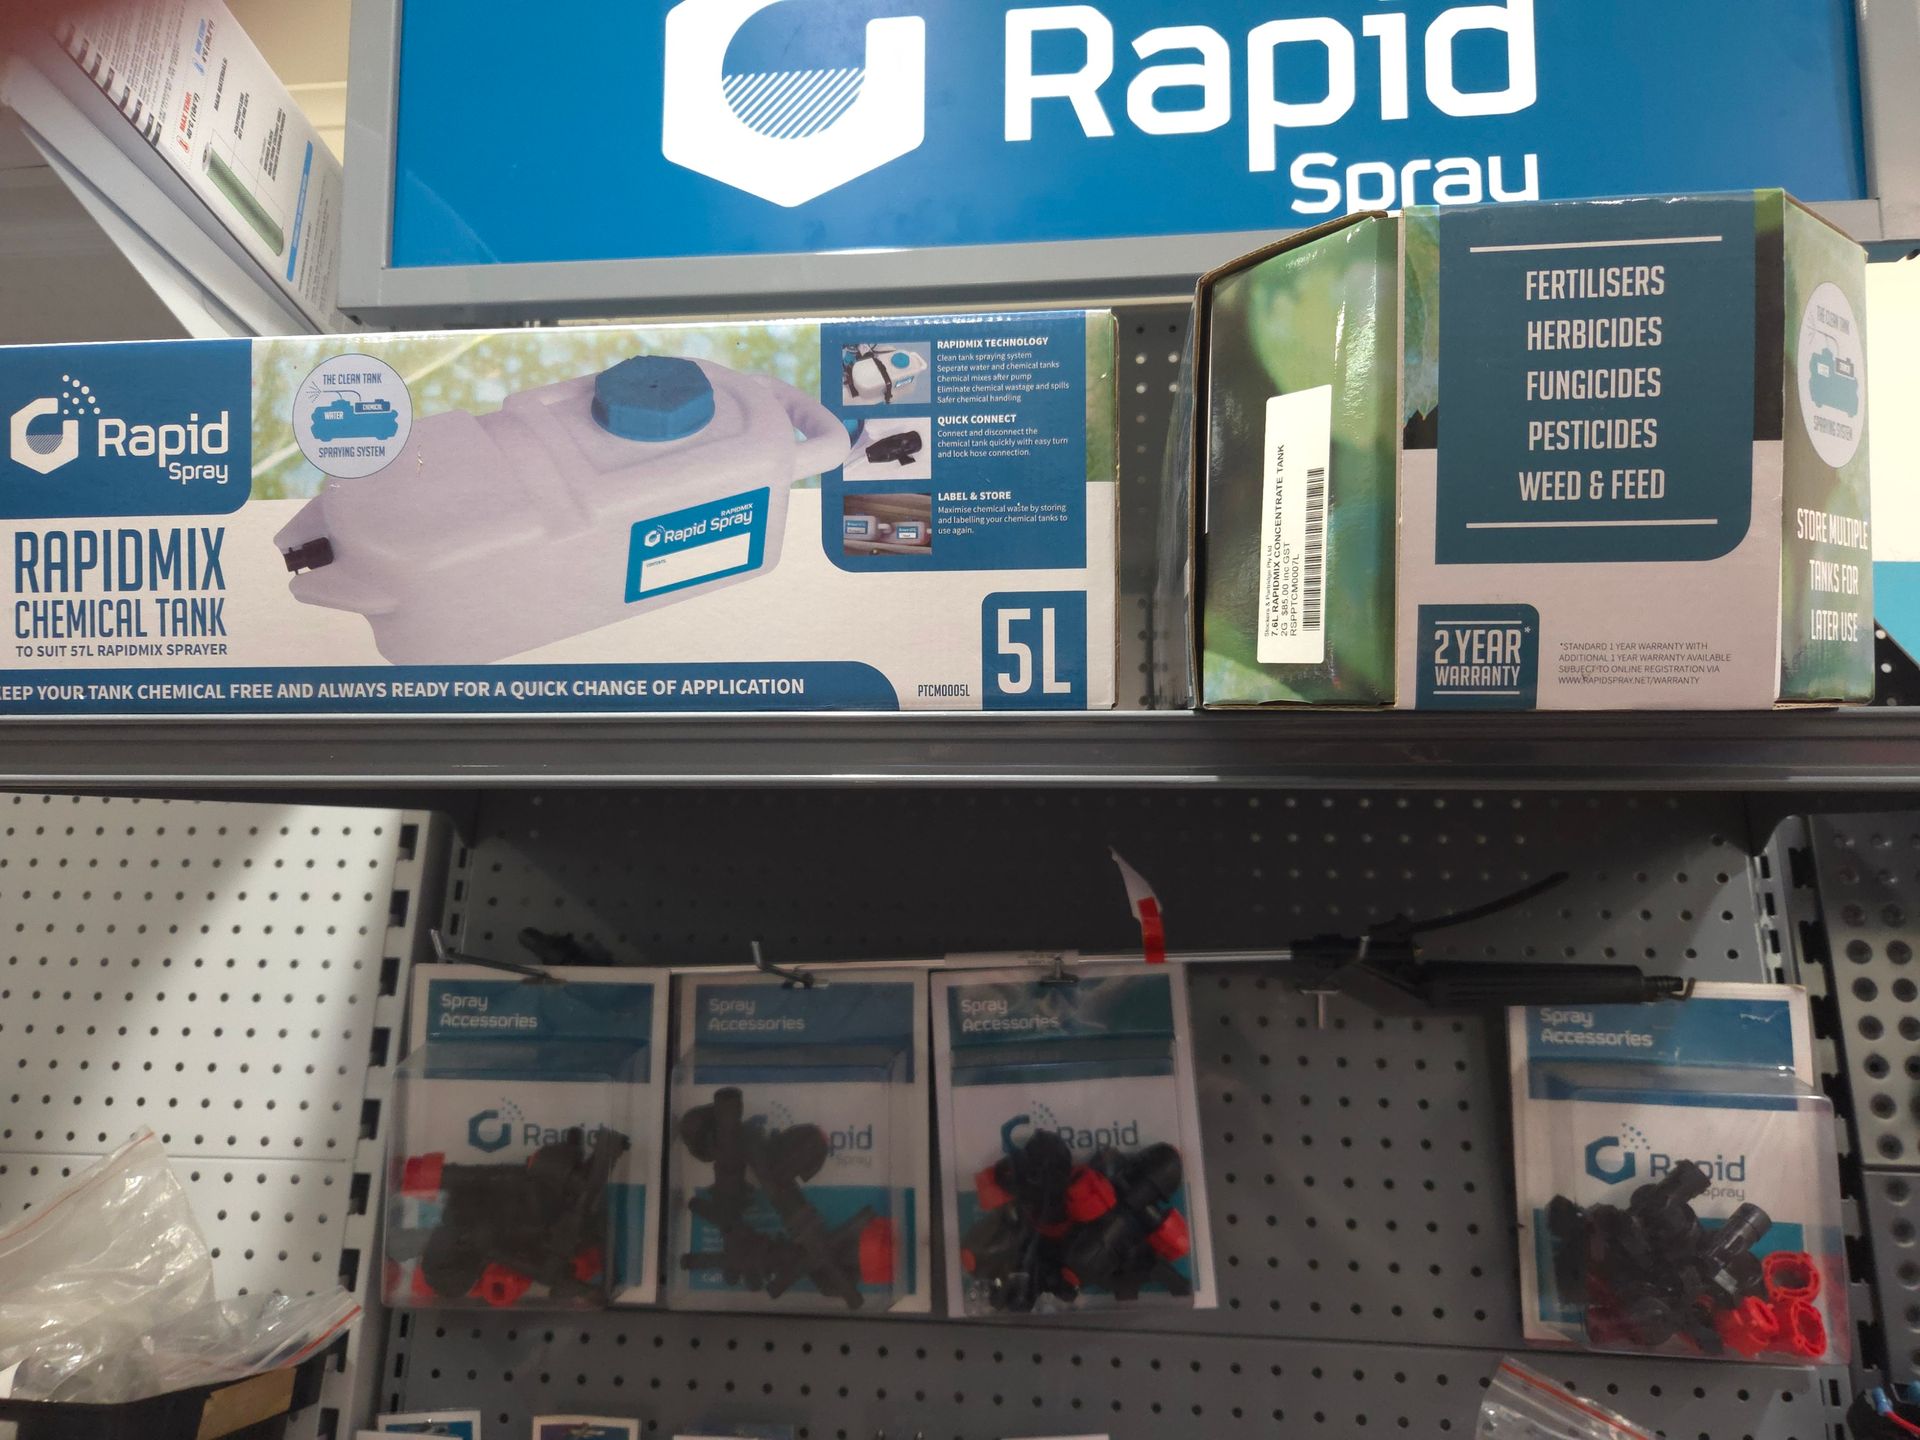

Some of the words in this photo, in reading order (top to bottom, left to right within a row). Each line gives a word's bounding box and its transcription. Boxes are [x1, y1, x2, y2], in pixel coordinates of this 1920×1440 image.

[1004, 0, 1537, 172] Rapid
[1526, 265, 1665, 301] FERTILISERS
[1527, 316, 1662, 351] HERBICIDES
[937, 339, 983, 350] RAPIDMIX
[985, 337, 1048, 348] TECHNOLOGY
[937, 353, 957, 362] Clean
[958, 352, 974, 361] tank
[975, 352, 1006, 363] spraying
[1006, 351, 1032, 361] system
[937, 364, 968, 375] Seperate
[969, 363, 990, 372] water
[991, 362, 1005, 371] and
[1006, 361, 1038, 370] chemical
[1040, 360, 1060, 369] tanks
[323, 373, 336, 385] THE
[338, 373, 361, 385] CLEAN
[362, 372, 382, 384] TANK
[937, 374, 969, 383] Chemical
[971, 373, 992, 382] mixes
[993, 372, 1009, 382] after
[1011, 373, 1032, 383] pump
[1527, 367, 1661, 401] FUNGICIDES
[937, 385, 971, 394] Eliminate
[971, 384, 1004, 393] chemical
[1004, 383, 1034, 394] wastage
[1035, 382, 1050, 391] and
[1050, 381, 1070, 391] spills
[937, 395, 956, 404] Safer
[956, 394, 988, 403] chemical
[989, 394, 1022, 404] handling
[937, 415, 969, 427] QUICK
[970, 414, 1017, 424] CONNECT
[98, 410, 229, 467] Rapid
[937, 429, 968, 438] Connect
[969, 428, 983, 437] and
[984, 427, 1024, 437] disconnect
[1025, 427, 1038, 436] the
[1528, 418, 1658, 451] PESTICIDES
[318, 446, 355, 458] SPRAYING
[356, 445, 386, 457] SYSTEM
[937, 439, 970, 448] chemical
[971, 438, 988, 447] tank
[989, 437, 1016, 449] quickly
[1016, 437, 1033, 446] with
[1034, 438, 1051, 449] easy
[1052, 437, 1068, 445] turn
[937, 450, 952, 459] and
[953, 449, 969, 458] lock
[969, 448, 988, 458] hose
[988, 448, 1031, 458] connection.
[1276, 444, 1285, 474] TANK
[169, 462, 229, 484] Spray
[1518, 470, 1581, 501] WEED
[1589, 469, 1604, 500] &
[1611, 468, 1665, 500] FEED
[938, 491, 968, 501] LABEL
[969, 491, 978, 501] &
[979, 491, 1012, 501] STORE
[721, 503, 754, 517] RAPIDMIX
[938, 505, 972, 514] Maximise
[972, 505, 1006, 513] chemical
[1006, 505, 1029, 513] waste
[1029, 504, 1039, 513] by
[1040, 503, 1067, 513] storing
[1274, 476, 1284, 558] CONCENTRATE
[664, 519, 707, 544] Rapid
[710, 510, 753, 532] Spray
[938, 516, 952, 524] and
[953, 515, 985, 525] labelling
[986, 516, 1004, 525] your
[1004, 514, 1037, 523] chemical
[1038, 514, 1059, 522] tanks
[1060, 514, 1068, 522] to
[1797, 508, 1827, 543] STORE
[1829, 514, 1868, 550] MULTIPLE
[938, 527, 952, 535] use
[952, 526, 975, 536] again.
[14, 527, 226, 594] RAPIDMIX
[1272, 561, 1281, 613] RAPIDMIX
[1809, 559, 1840, 594] TANKS
[1841, 564, 1859, 596] FOR
[1281, 583, 1289, 616] $85.00
[1290, 554, 1299, 637] RSPPTCM0007L
[15, 599, 148, 639] CHEMICAL
[156, 598, 227, 637] TANK
[1271, 615, 1279, 637] 7.6L
[1811, 609, 1839, 641] LATER
[1841, 611, 1858, 642] USE
[1281, 622, 1288, 637] 2G
[16, 646, 33, 657] TO
[37, 645, 67, 657] SUIT
[70, 645, 94, 657] 57L
[97, 644, 163, 657] RAPIDMIX
[166, 643, 228, 656] SPRAYER
[997, 607, 1071, 694] 5L
[1434, 630, 1448, 664] 2
[1615, 642, 1637, 650] YEAR
[1638, 642, 1683, 650] WARRANTY
[1685, 642, 1708, 650] WITH
[1559, 654, 1608, 662] ADDITIONAL
[1617, 654, 1638, 662] YEAR
[1639, 653, 1685, 661] WARRANTY
[1686, 653, 1732, 662] AVAILABLE
[1434, 665, 1520, 687] WARRANTY
[1558, 665, 1596, 673] SUBJECT
[1599, 665, 1610, 673] TO
[1611, 665, 1643, 673] ONLINE
[1644, 665, 1705, 673] REGISTRATION
[1706, 665, 1720, 673] VIA
[0, 685, 34, 701] EEP
[37, 685, 86, 700] YOUR
[88, 684, 134, 700] TANK
[137, 684, 226, 699] CHEMICAL
[230, 684, 273, 699] FREE
[276, 683, 314, 698] AND
[318, 683, 387, 698] ALWAYS
[391, 682, 449, 697] READY
[453, 682, 491, 697] FOR
[494, 682, 507, 696] A
[510, 681, 568, 700] QUICK
[572, 680, 647, 696] CHANGE
[651, 680, 677, 696] OF
[681, 678, 804, 695] APPLICATION
[917, 684, 970, 697] PTCM0005L
[441, 993, 488, 1012] Spray
[708, 998, 756, 1016] Spray
[961, 998, 1008, 1016] Spray
[440, 1012, 538, 1029] Accessories
[708, 1014, 806, 1033] Accessories
[962, 1014, 1060, 1033] Accessories
[1540, 1009, 1593, 1029] Spray
[1540, 1030, 1653, 1047] Accessories
[1056, 1120, 1139, 1151] Rapid
